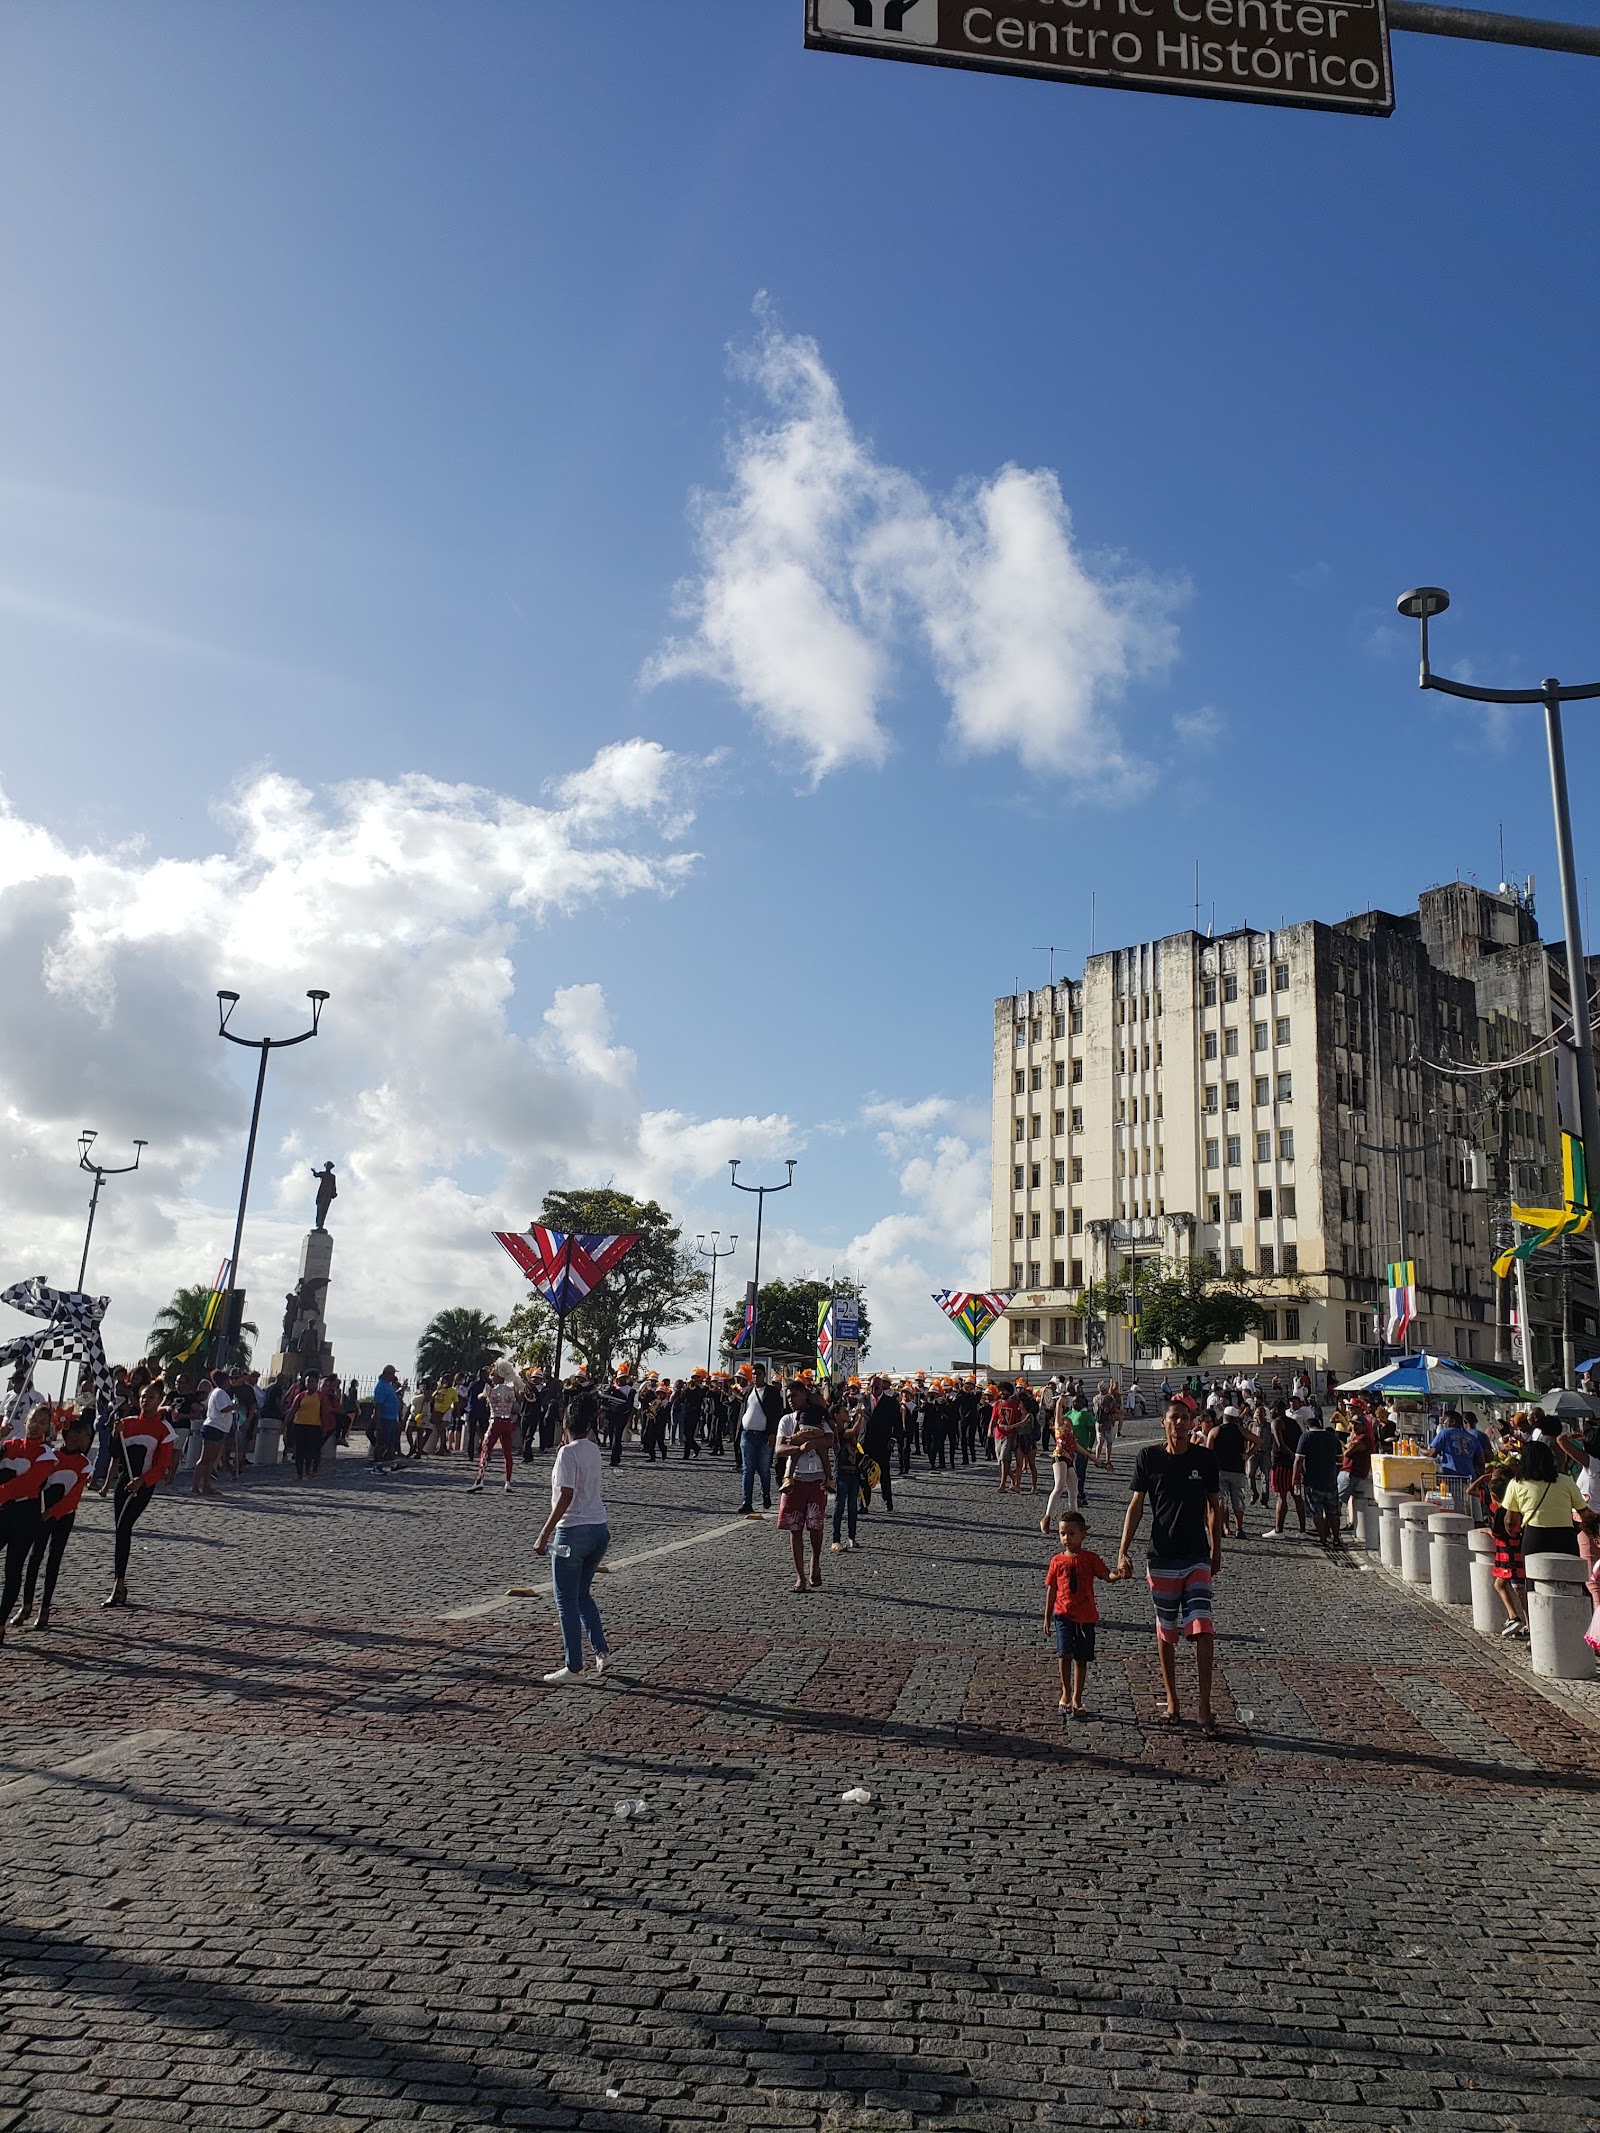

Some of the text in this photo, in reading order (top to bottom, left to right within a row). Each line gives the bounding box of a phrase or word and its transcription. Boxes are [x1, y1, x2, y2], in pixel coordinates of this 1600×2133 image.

[962, 7, 1380, 89] Centro Histórico
[1172, 0, 1349, 38] Center
